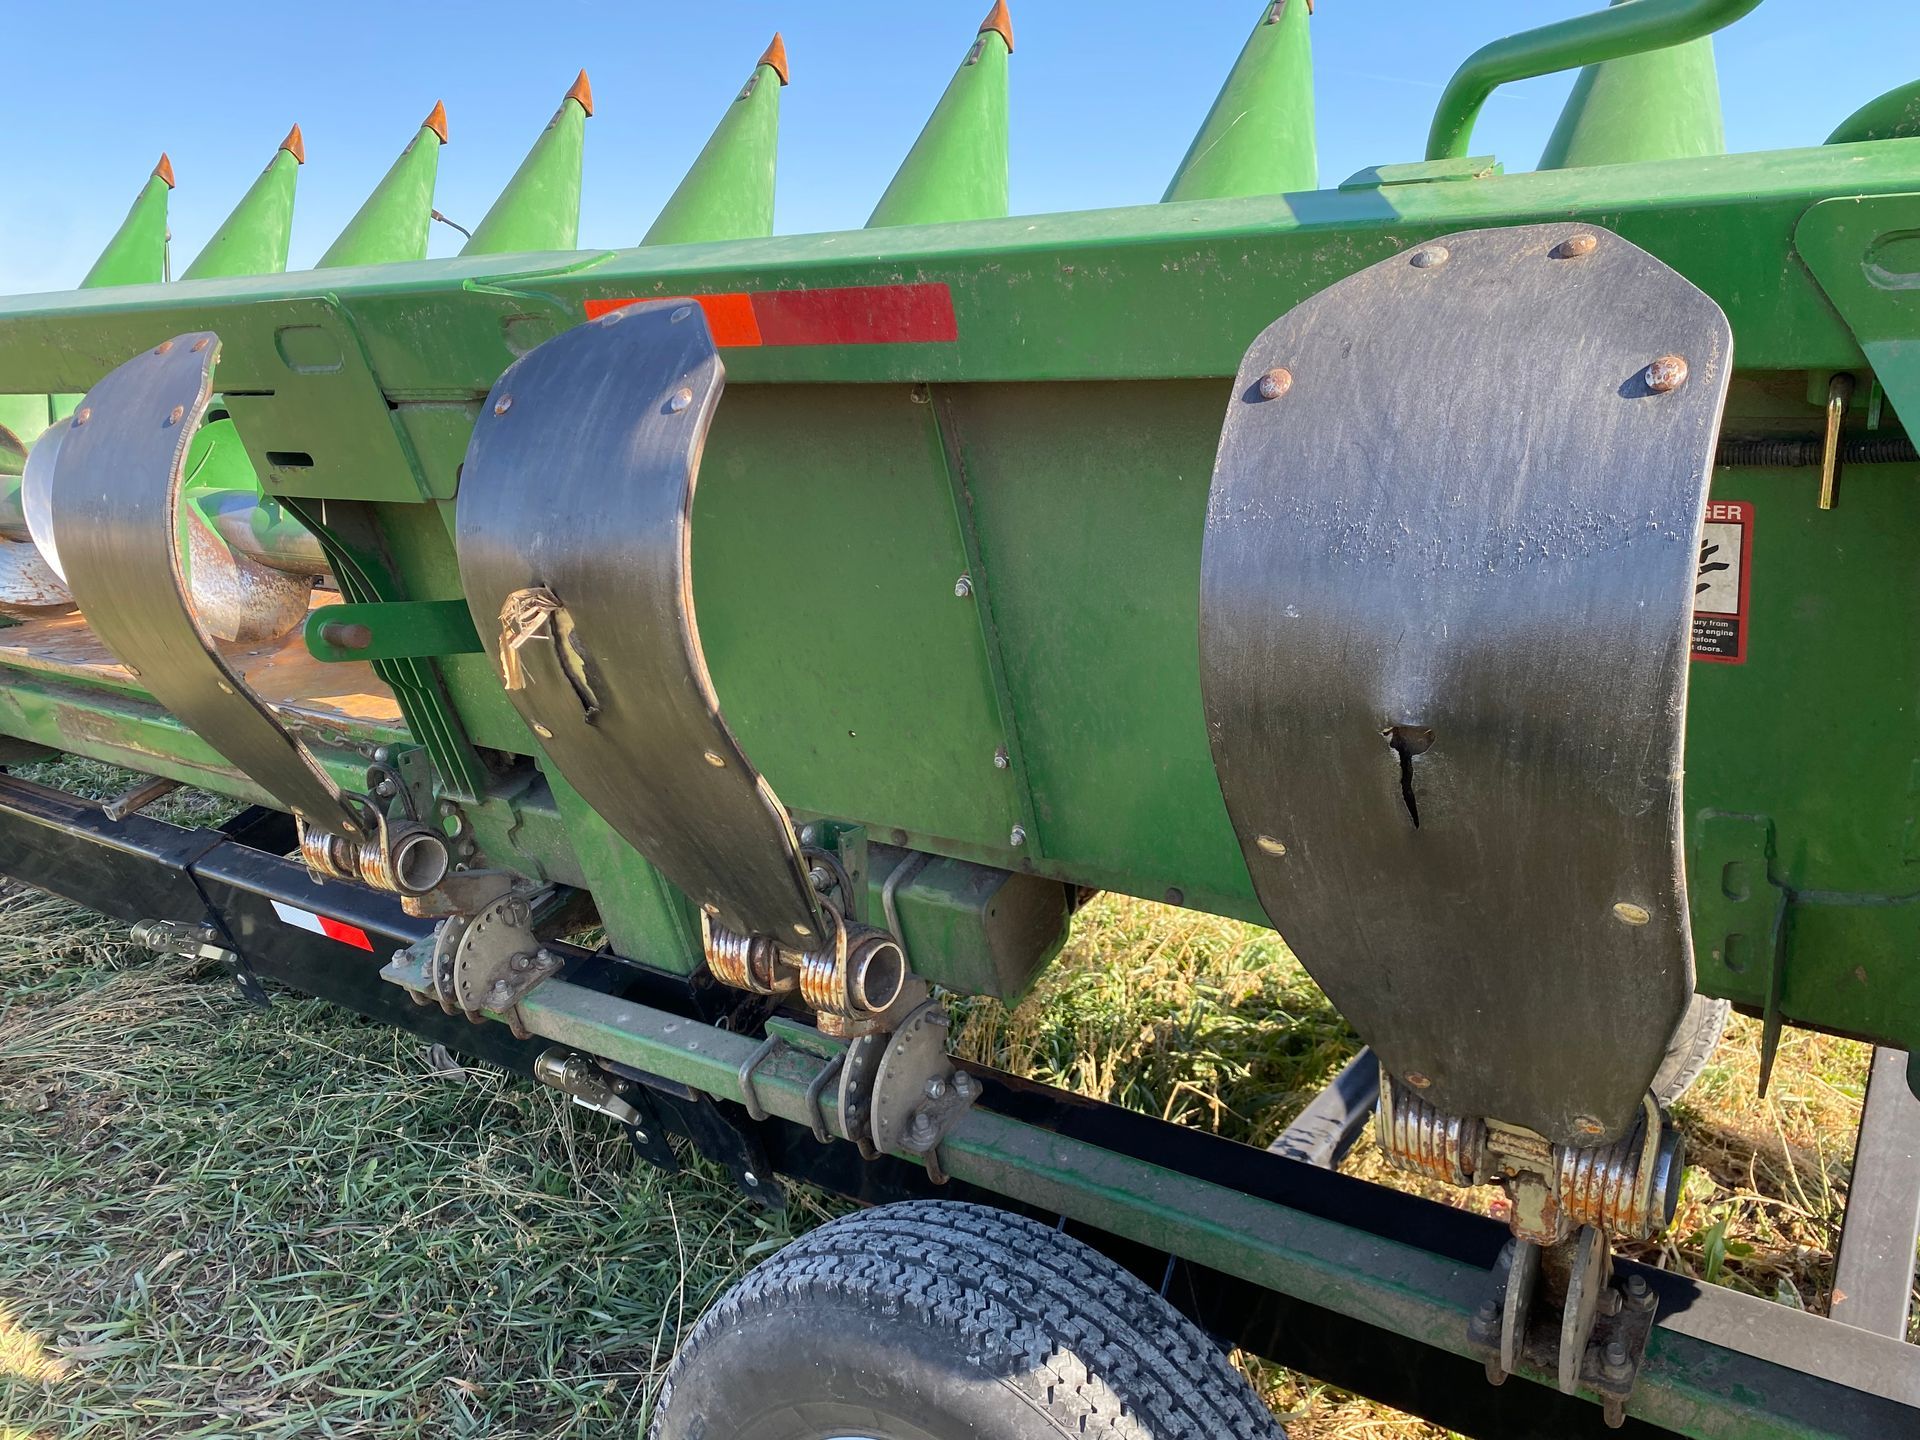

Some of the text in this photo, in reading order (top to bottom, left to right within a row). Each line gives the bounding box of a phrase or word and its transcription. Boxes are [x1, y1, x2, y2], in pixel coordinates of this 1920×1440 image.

[1709, 620, 1729, 628] from
[1705, 629, 1734, 637] engine
[1696, 645, 1723, 653] doors.
